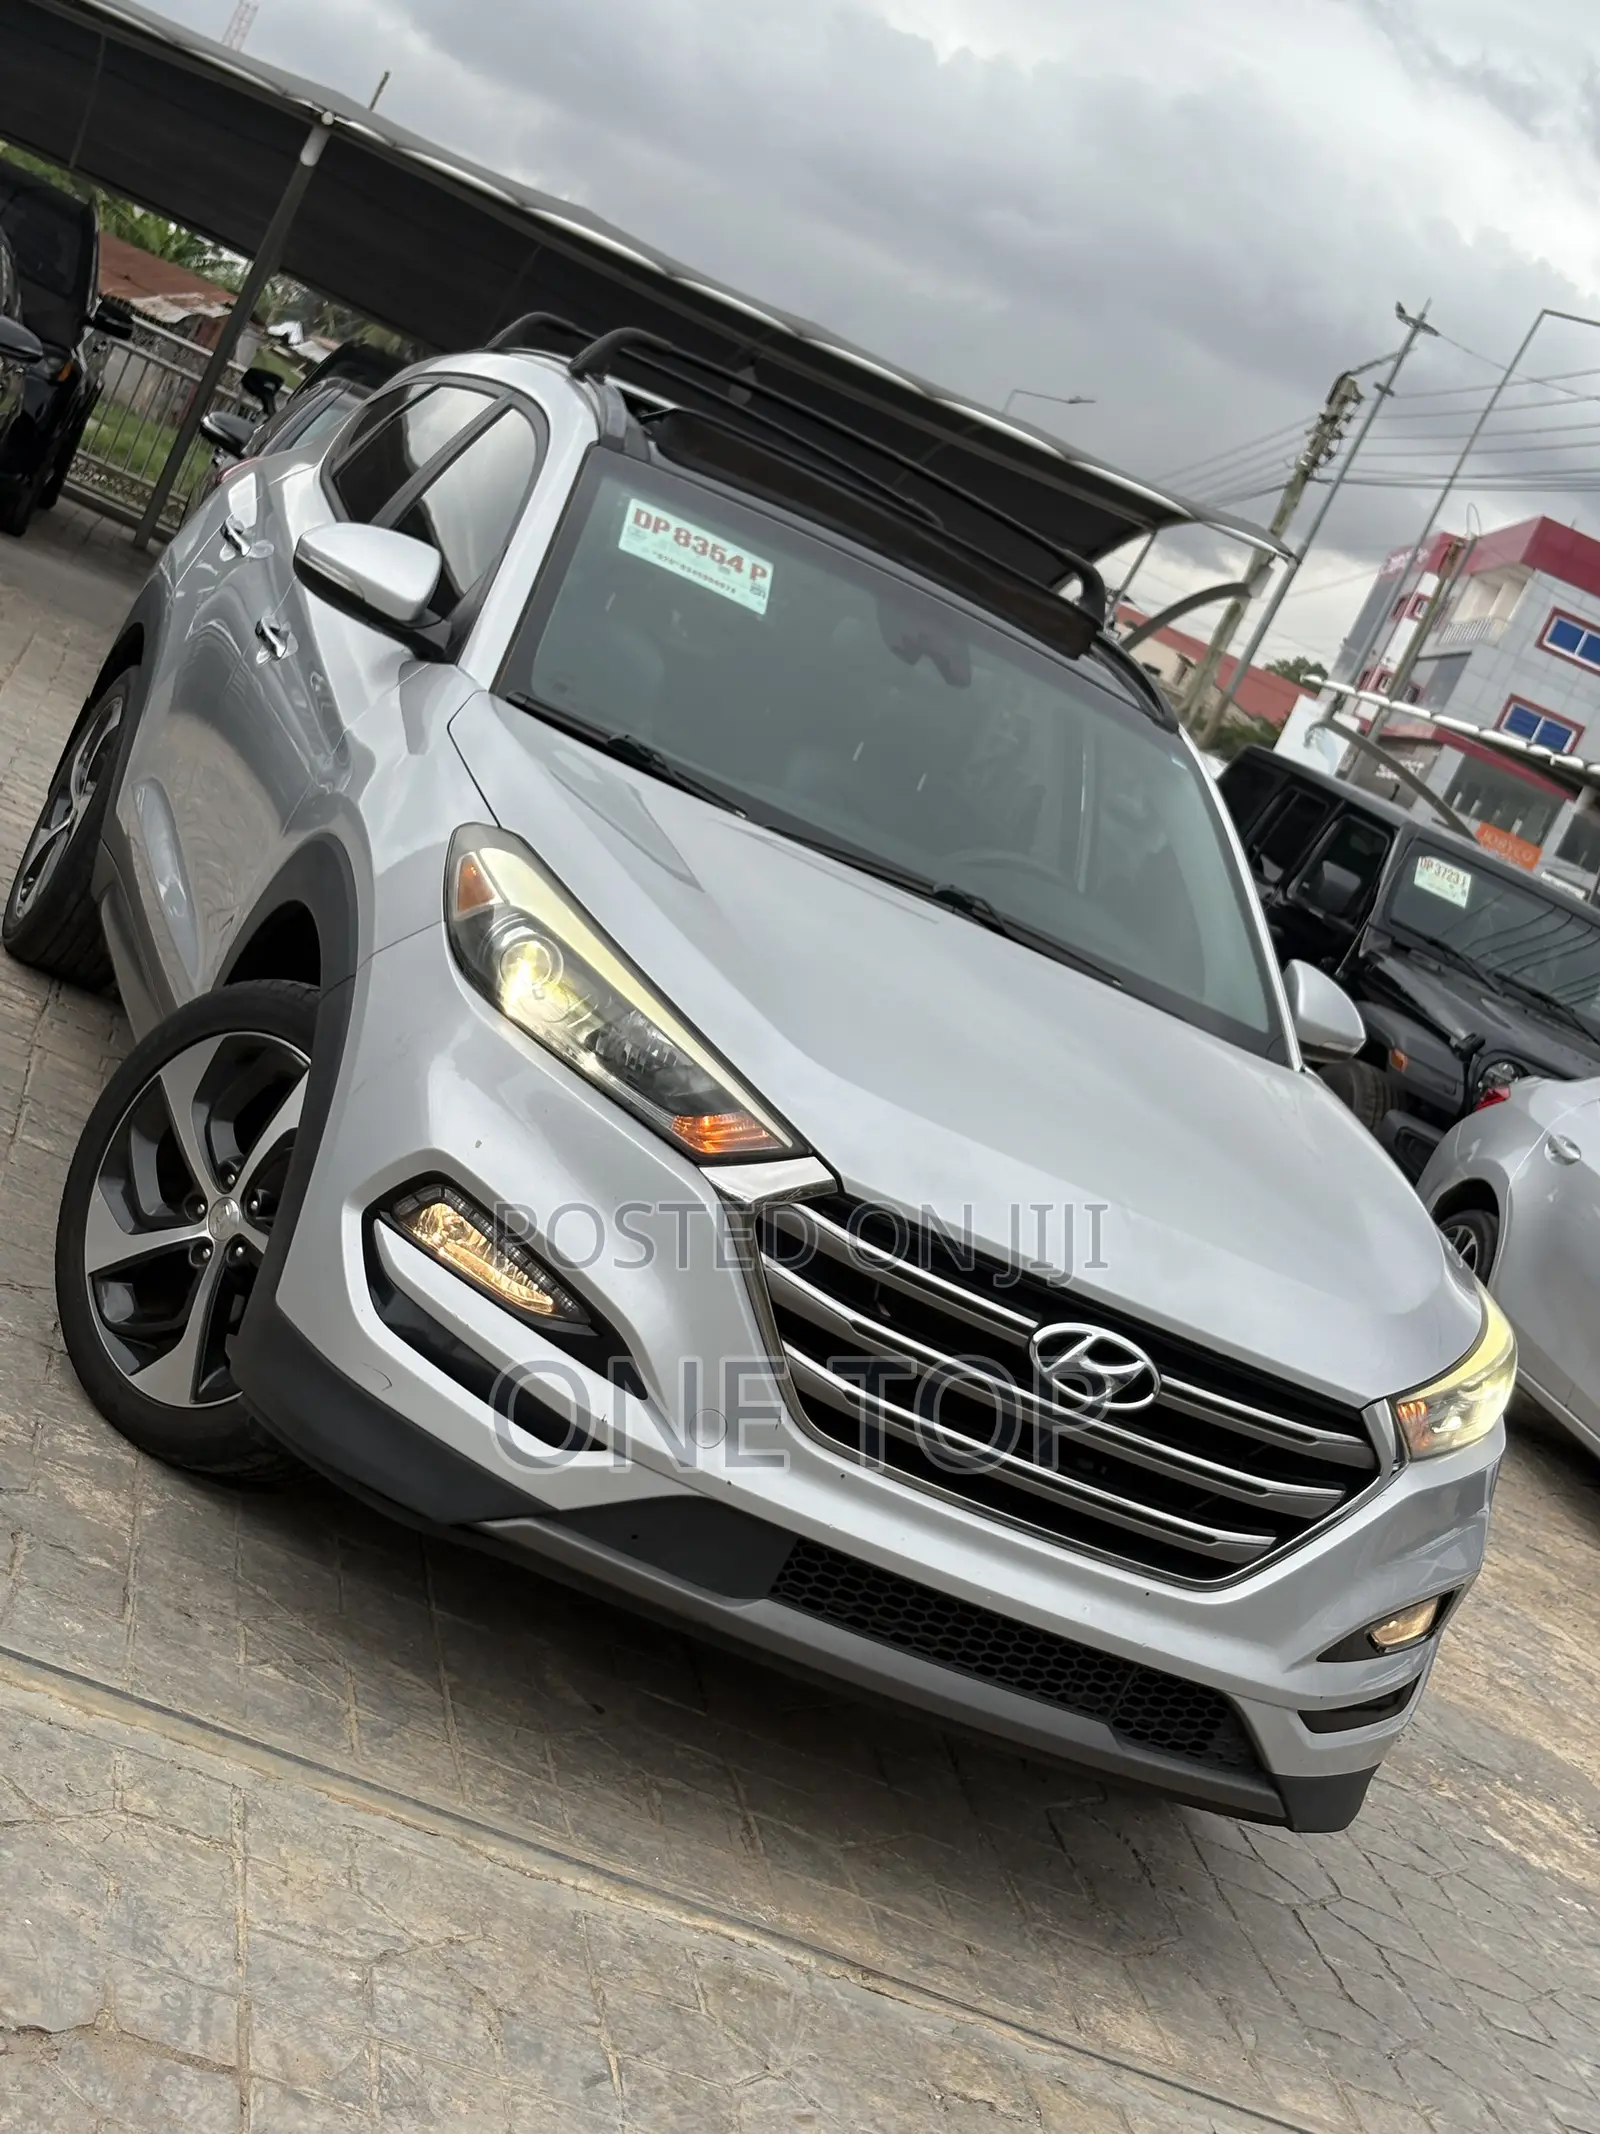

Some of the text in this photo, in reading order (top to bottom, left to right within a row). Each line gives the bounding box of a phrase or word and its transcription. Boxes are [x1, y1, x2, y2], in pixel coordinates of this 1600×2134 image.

[632, 508, 671, 534] DP
[673, 527, 744, 574] 8354
[750, 562, 767, 582] P
